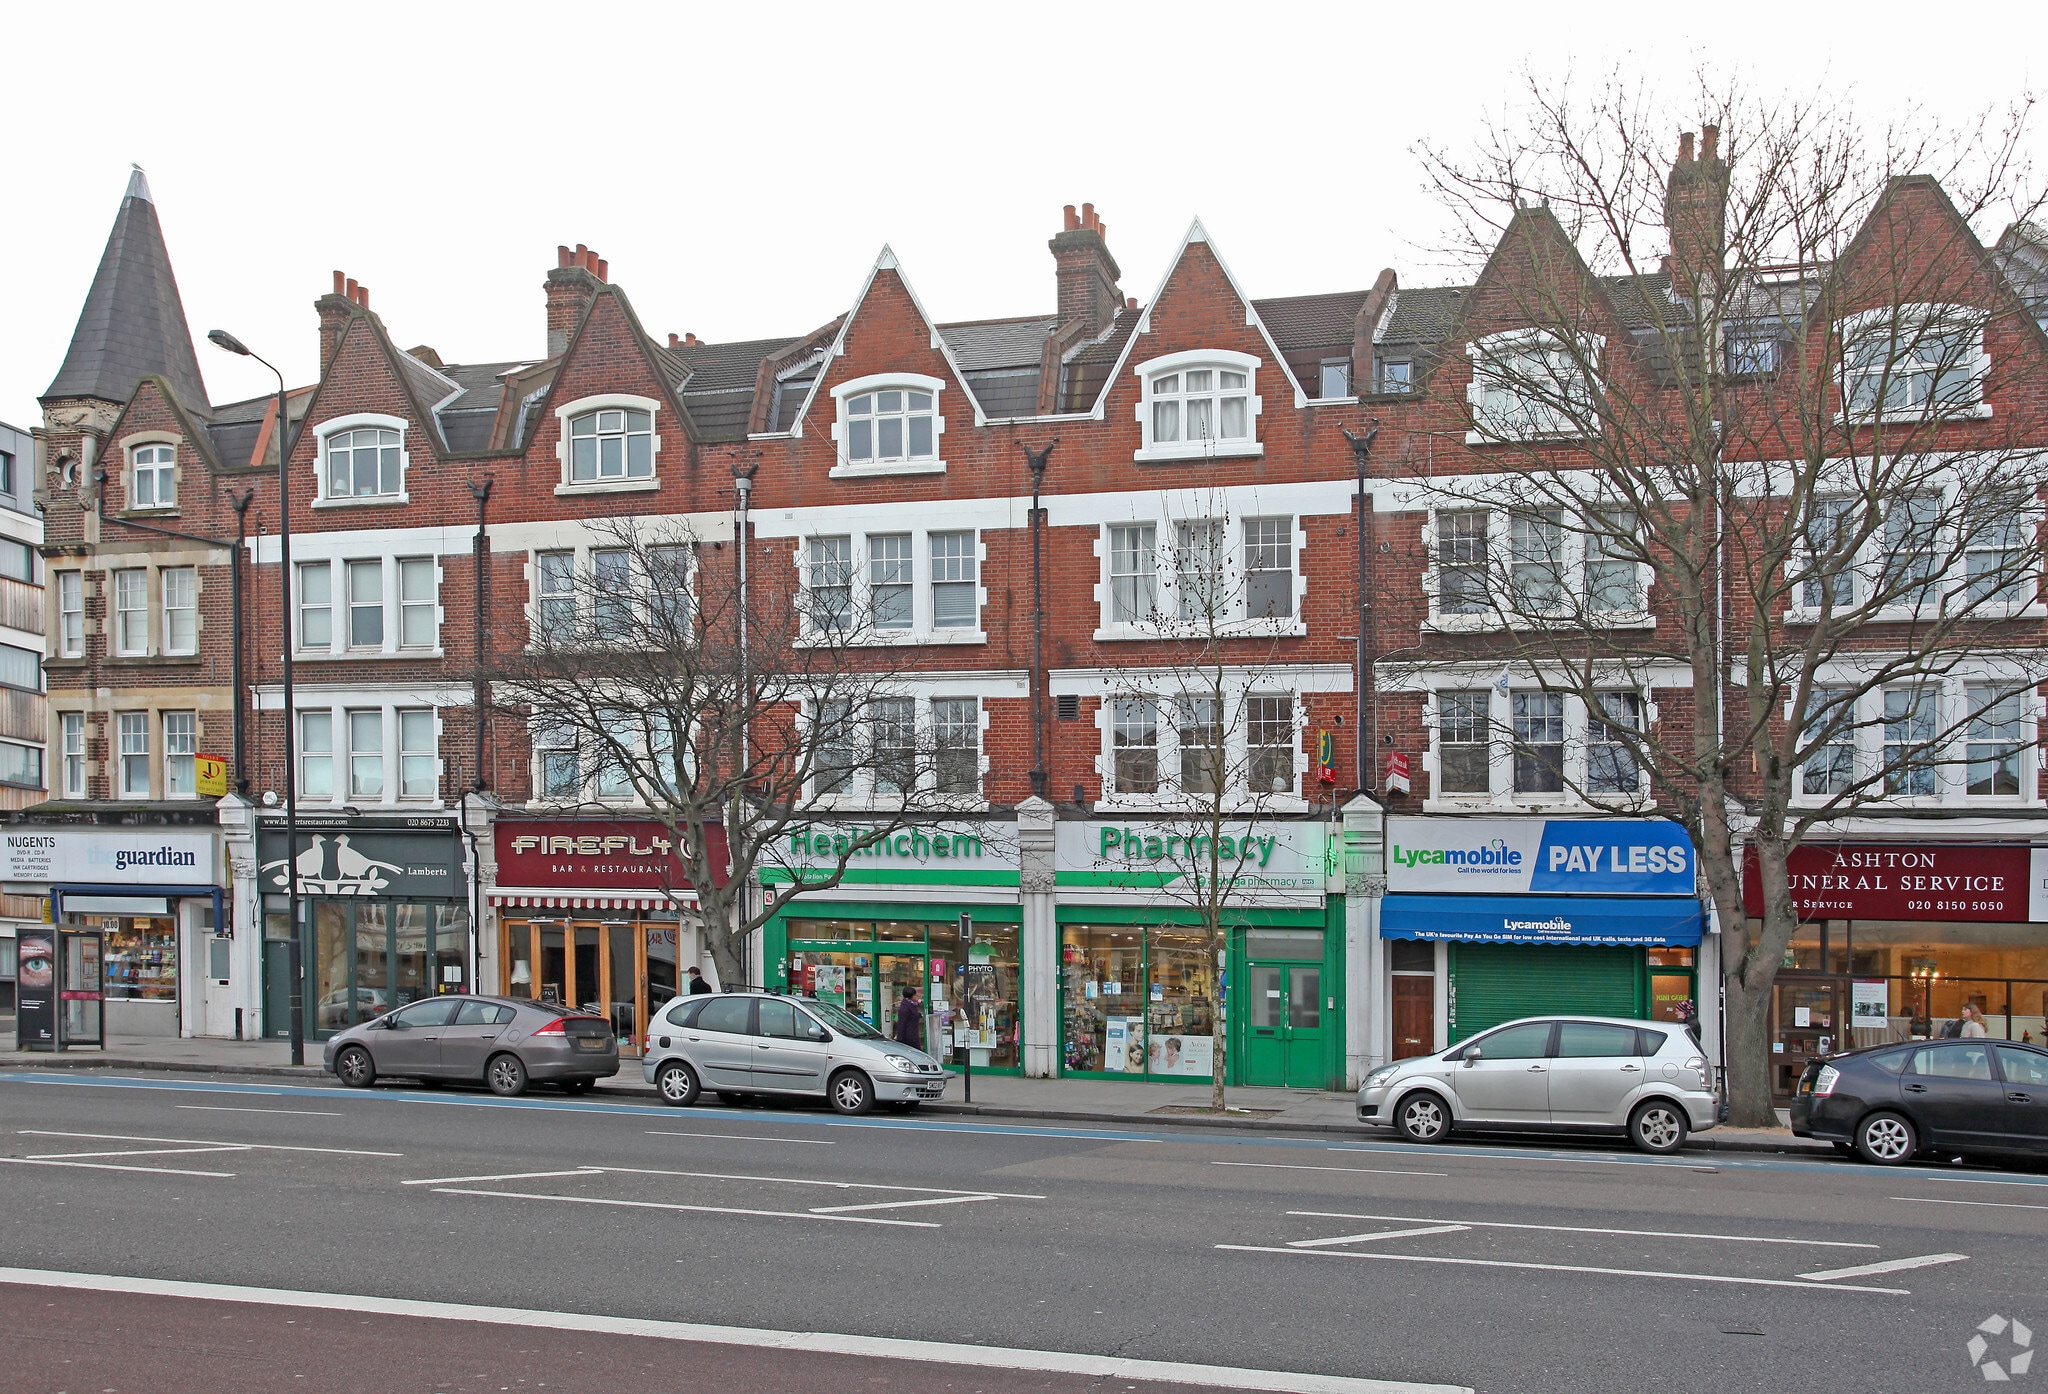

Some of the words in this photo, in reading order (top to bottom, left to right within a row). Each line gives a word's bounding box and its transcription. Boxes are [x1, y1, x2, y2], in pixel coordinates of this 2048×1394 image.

[264, 817, 348, 825] www.lamertsrestaurant.com
[8, 837, 55, 847] NUGENTS
[511, 836, 672, 855] FIREFLY
[790, 825, 981, 858] Healthchem
[1100, 827, 1275, 867] Pharmacy
[115, 846, 195, 870] guardian
[1394, 844, 1522, 868] Lycamobile
[1550, 846, 1603, 872] PAY
[1611, 846, 1687, 873] LESS
[1832, 853, 1936, 868] ASHTON
[408, 867, 447, 876] Lamberts
[552, 865, 573, 873] BAR
[580, 865, 587, 873] &
[594, 865, 669, 874] RESTAURANT
[1248, 877, 1297, 888] pharmacy
[1788, 875, 1888, 890] UNERAL
[1900, 876, 2005, 891] SERVICE
[1803, 900, 1853, 909] SERVICE
[1908, 901, 1931, 910] 020
[1937, 901, 1966, 911] 8150
[1972, 902, 2004, 911] 5050
[1504, 919, 1571, 930] Lycamobile
